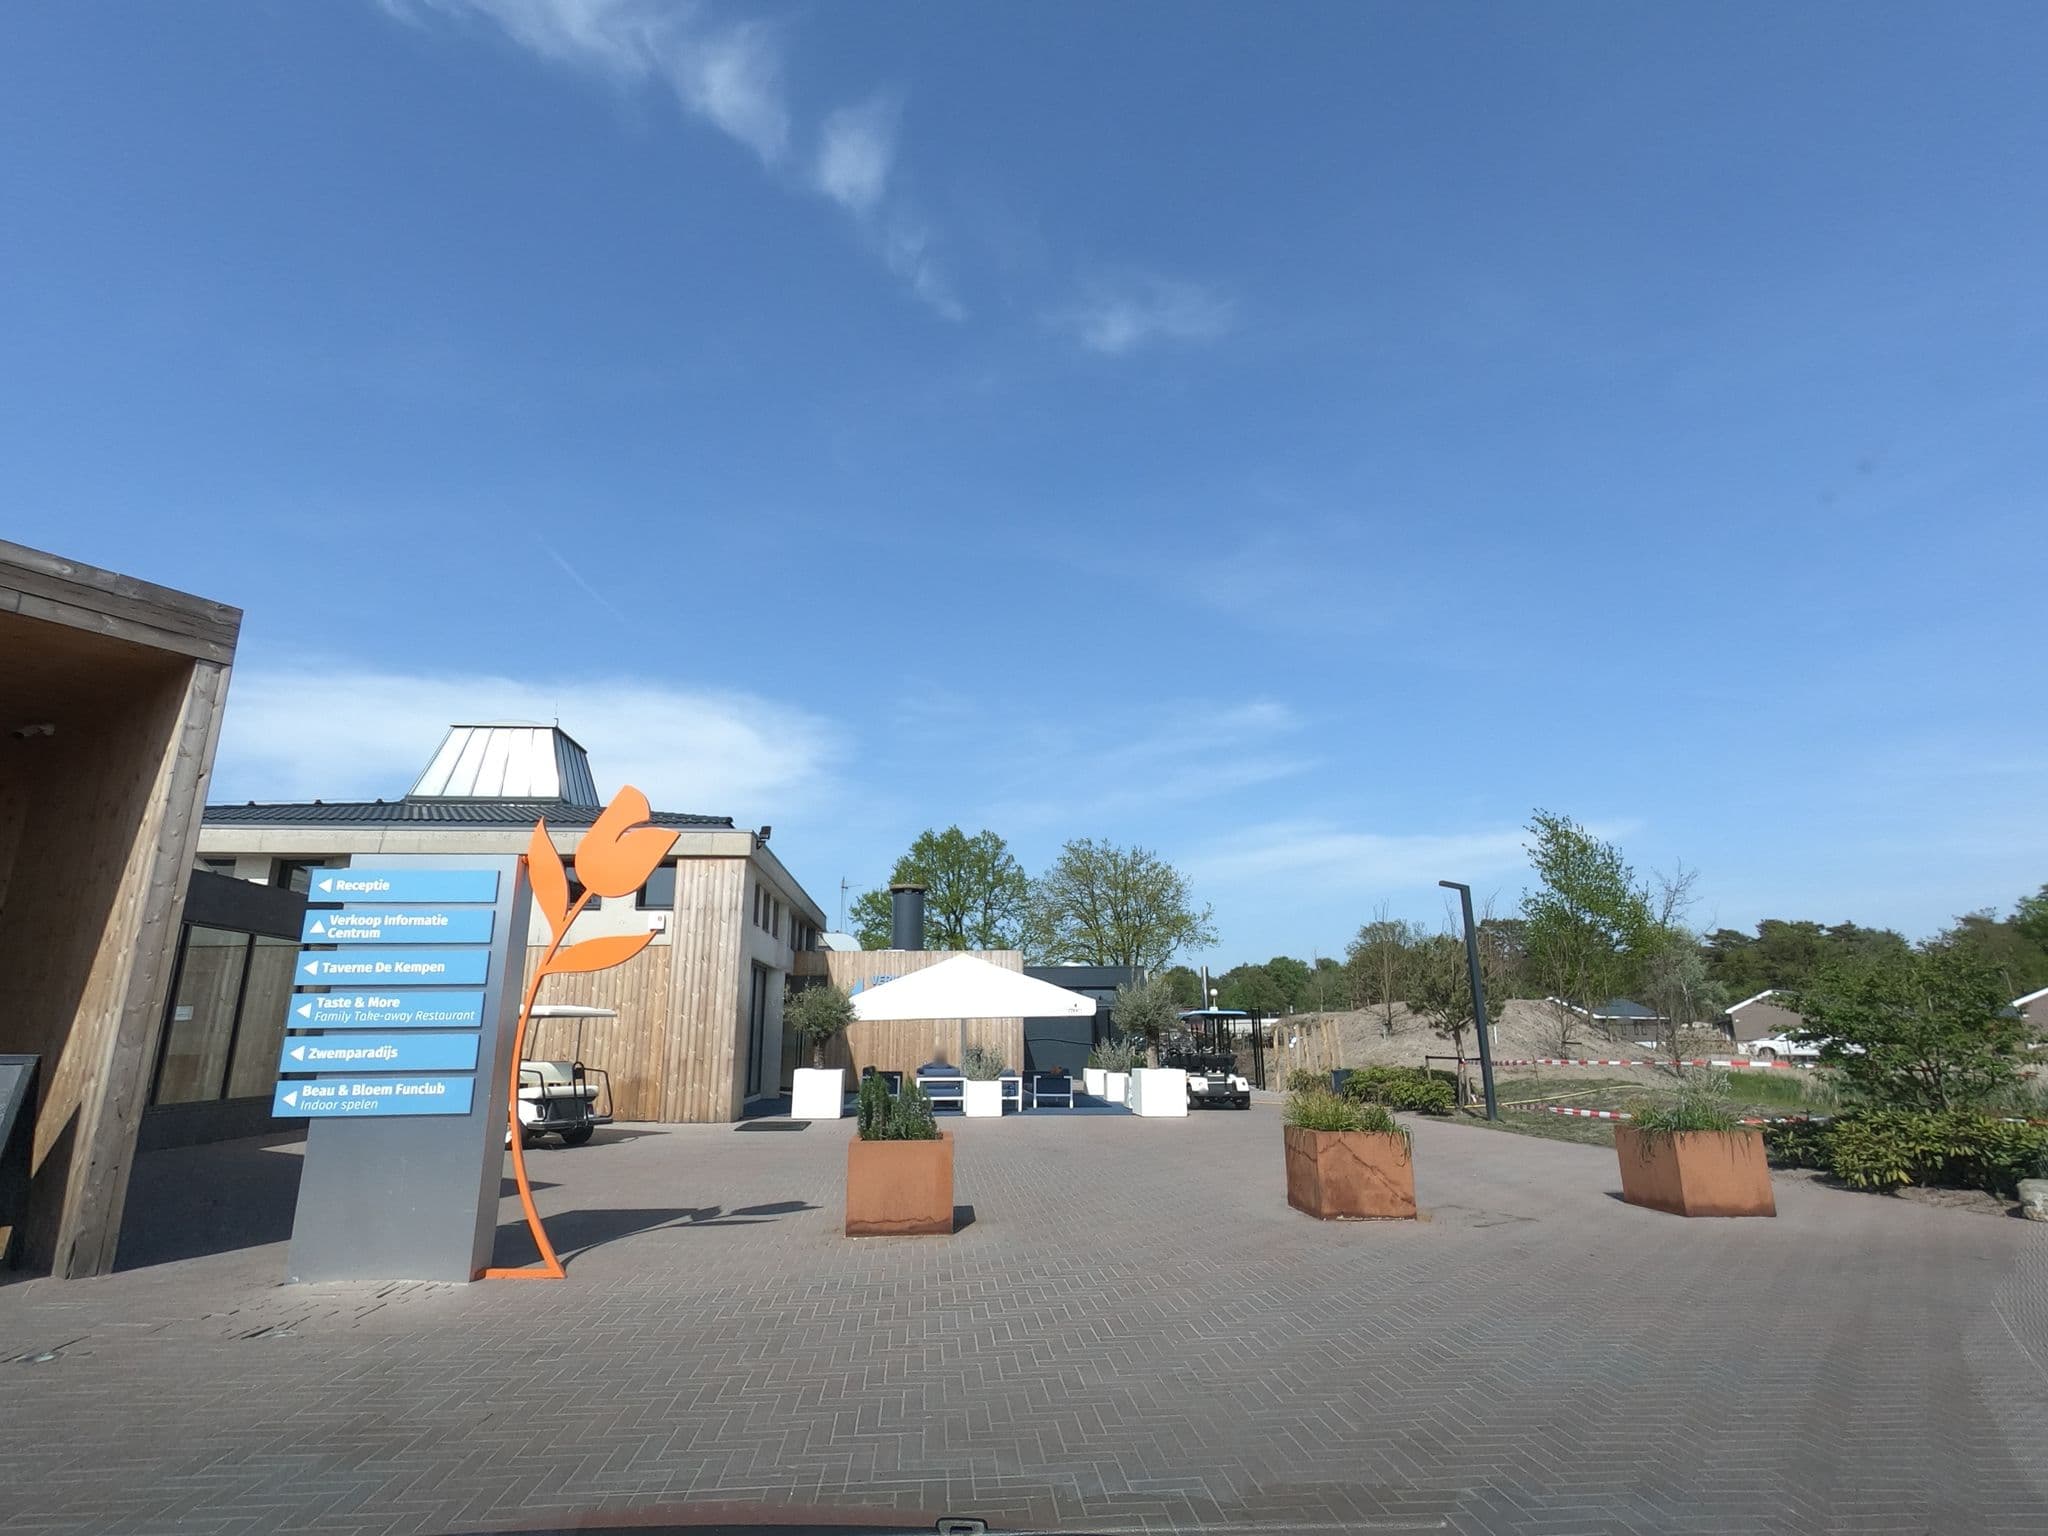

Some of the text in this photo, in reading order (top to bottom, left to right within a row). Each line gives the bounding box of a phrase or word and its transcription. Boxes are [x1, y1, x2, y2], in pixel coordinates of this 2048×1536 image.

[336, 878, 390, 893] Receptie
[329, 913, 449, 928] Verkoop Informatie
[327, 927, 381, 939] Centrum
[322, 961, 445, 975] Taverne De Kempen
[317, 997, 401, 1008] Taste & More
[314, 1010, 475, 1023] Family Take-away Restaurant
[308, 1045, 398, 1061] Zwemparadijs
[302, 1082, 445, 1097] Beau & Bloem Funclub
[300, 1099, 378, 1112] Indoor spelen
